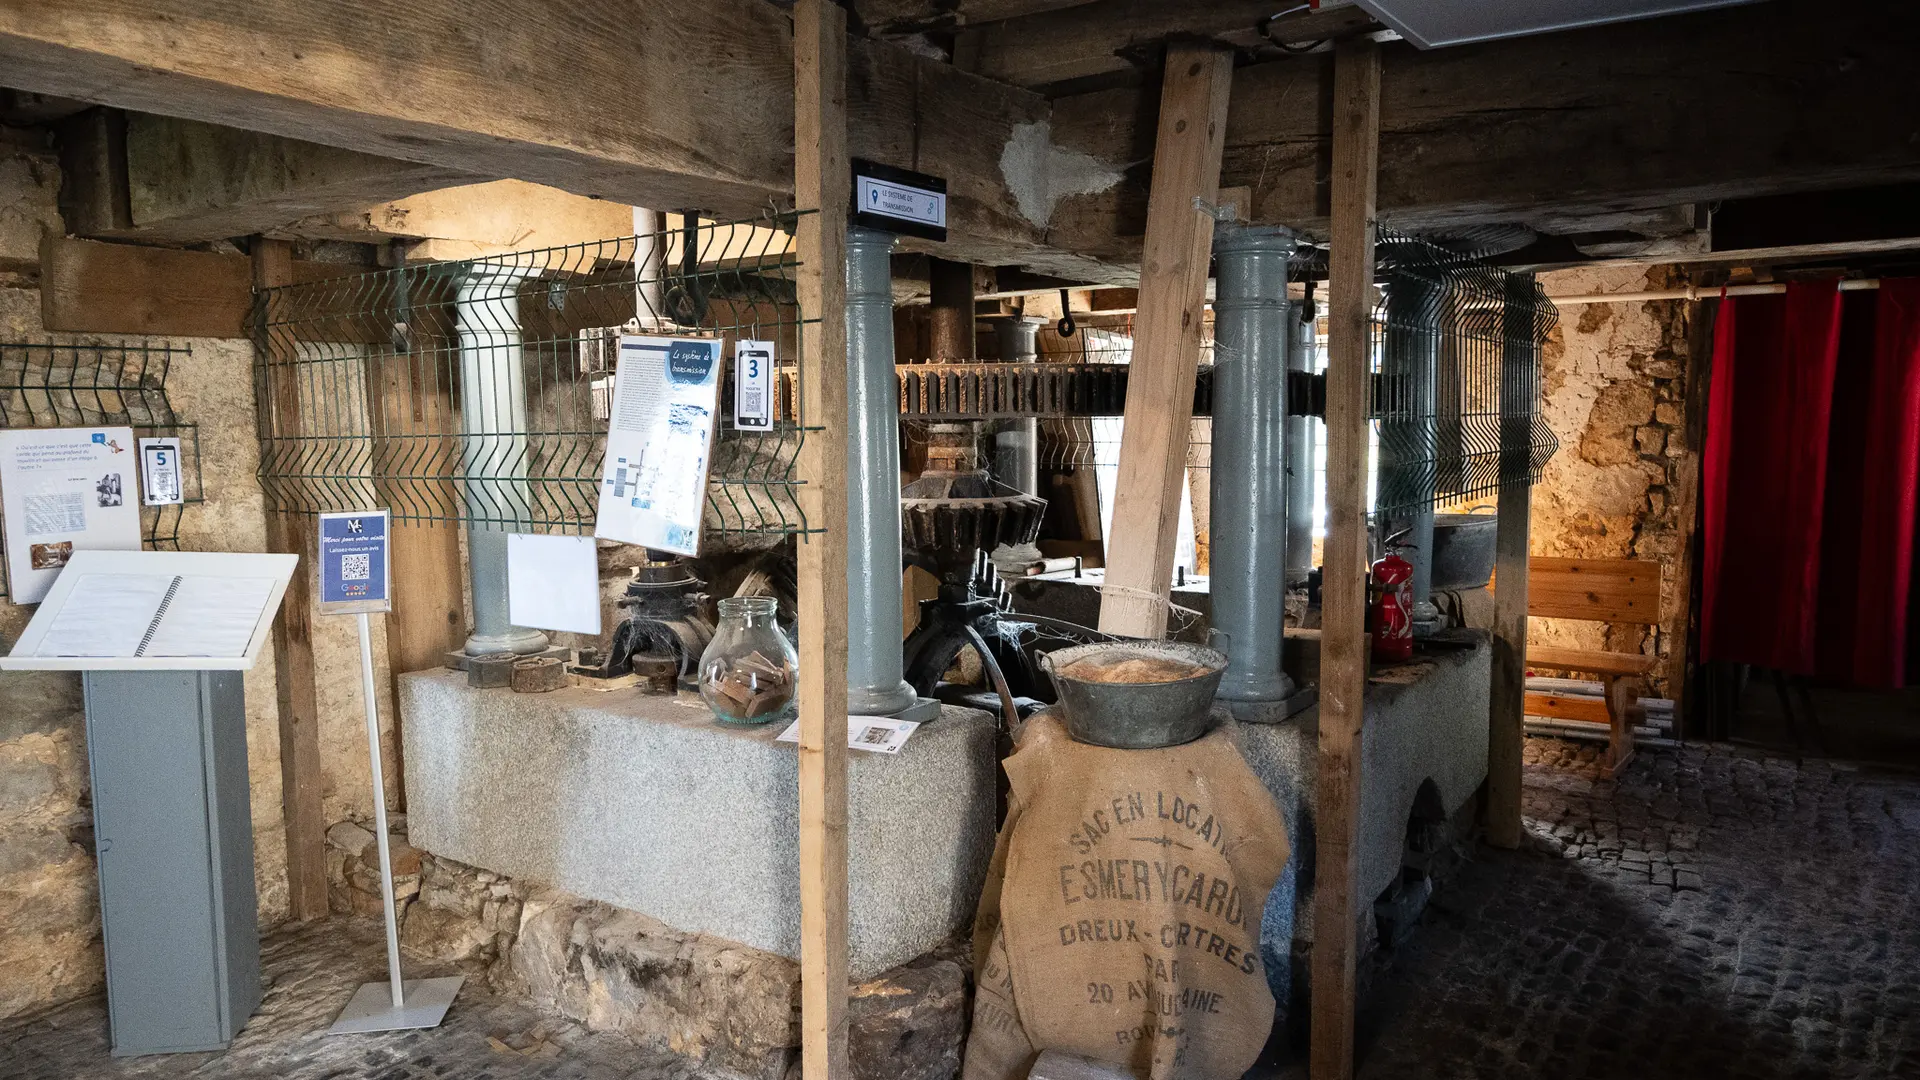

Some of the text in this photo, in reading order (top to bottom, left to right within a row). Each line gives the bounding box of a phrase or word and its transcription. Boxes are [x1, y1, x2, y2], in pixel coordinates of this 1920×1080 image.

[906, 195, 913, 203] DE
[882, 202, 914, 214] TRANSMISSION
[672, 349, 710, 362] Le système de
[672, 362, 707, 376] transmission
[748, 359, 759, 379] 3
[156, 451, 167, 466] 5
[1069, 809, 1110, 855] SAC
[1111, 791, 1146, 825] EN
[1058, 919, 1142, 947] DREUX
[1160, 922, 1260, 976] CRTRES
[1087, 981, 1114, 1004] 20
